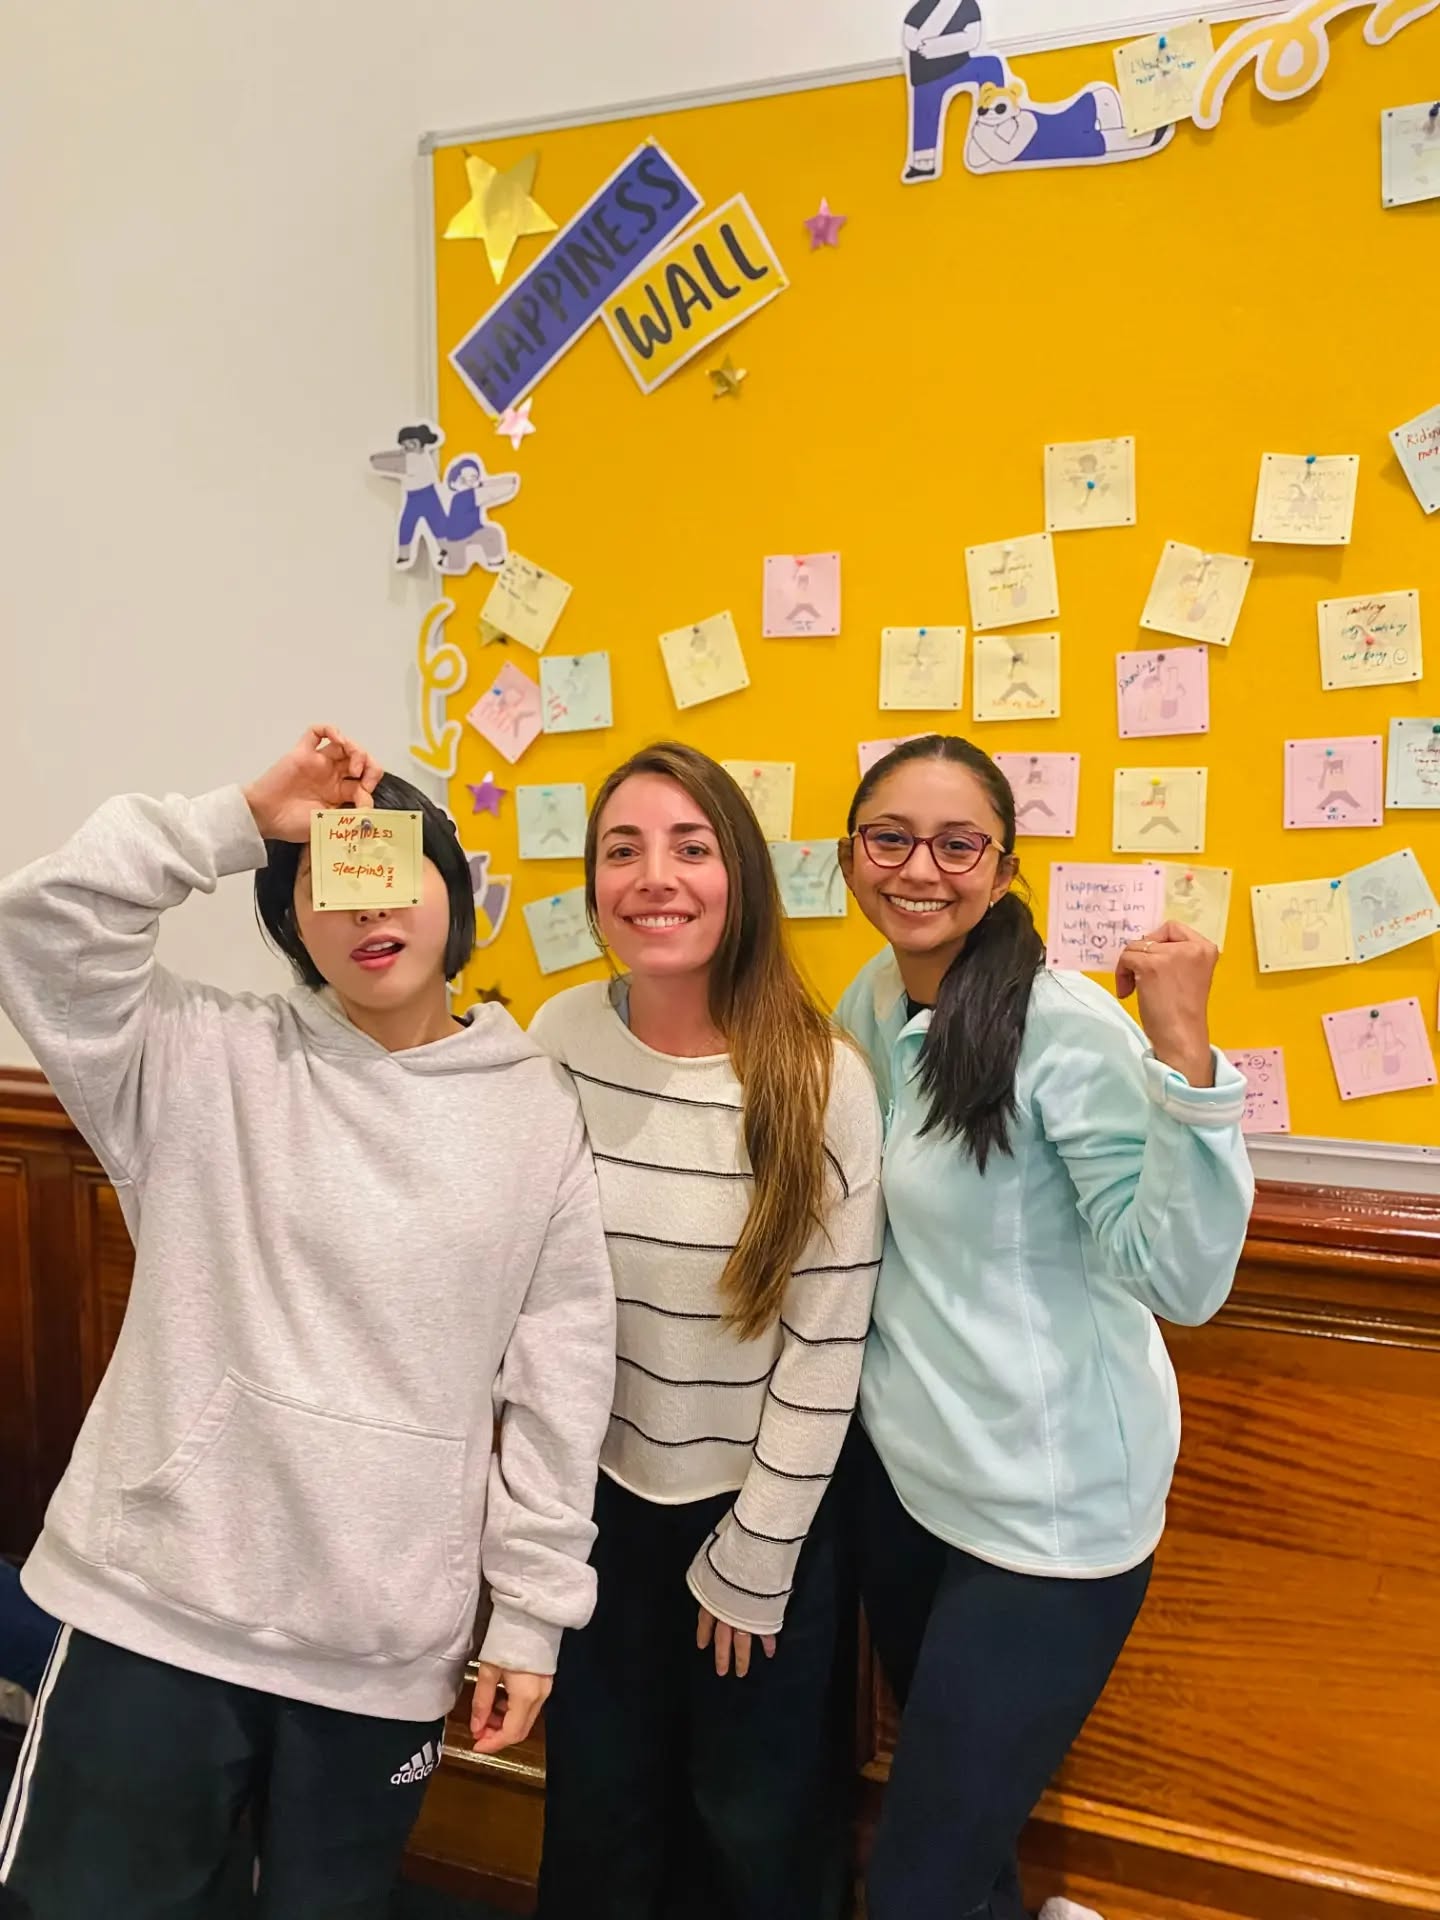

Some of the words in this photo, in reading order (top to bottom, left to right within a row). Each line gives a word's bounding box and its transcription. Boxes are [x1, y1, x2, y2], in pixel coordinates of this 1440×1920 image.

[462, 157, 681, 397] HAPPINESS
[615, 223, 769, 359] WALL
[1407, 427, 1440, 448] Ridin
[1065, 900, 1101, 913] when
[1108, 899, 1118, 911] I
[1123, 903, 1145, 911] am
[1063, 917, 1089, 929] with
[390, 1759, 435, 1785] adida
